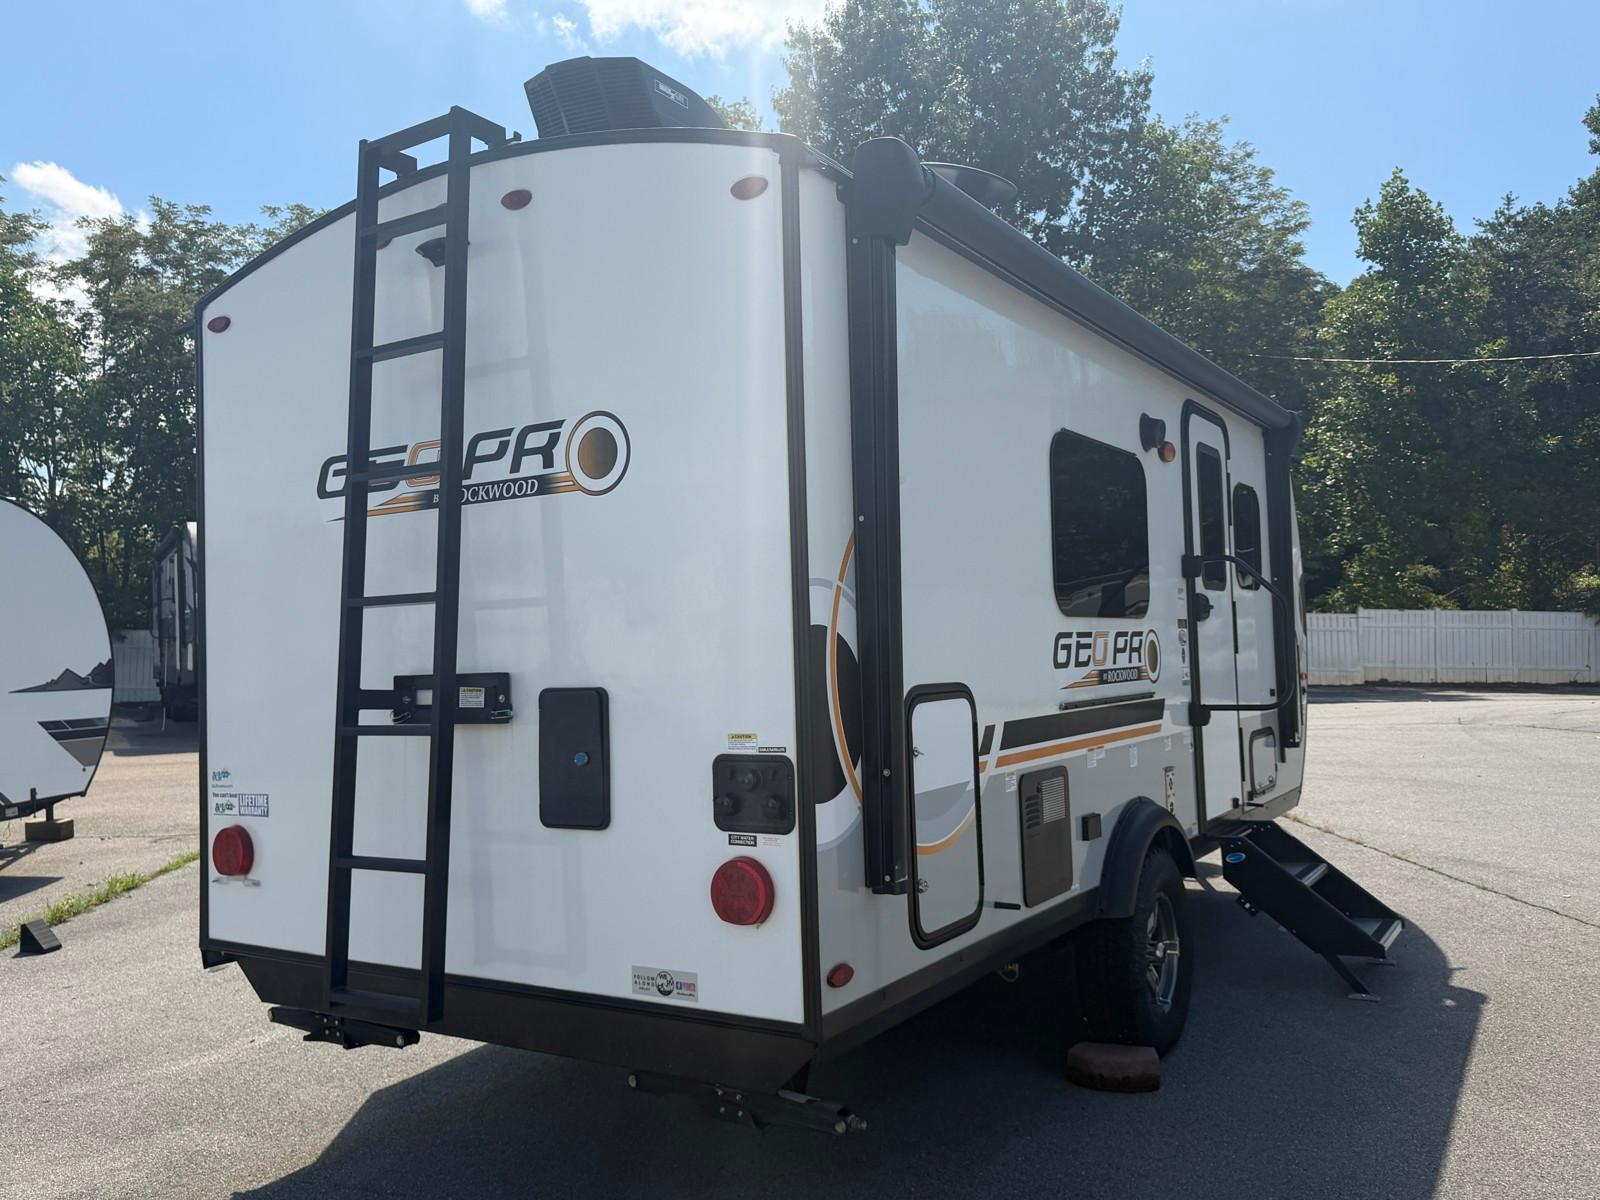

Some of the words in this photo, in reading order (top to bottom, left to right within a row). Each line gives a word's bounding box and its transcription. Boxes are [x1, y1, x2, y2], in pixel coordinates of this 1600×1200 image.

[462, 410, 631, 496] PRO
[1053, 631, 1109, 669] GEO
[1113, 629, 1161, 684] PRO
[1108, 669, 1138, 682] ROCKWOOD
[240, 794, 268, 806] LIFETIME
[240, 806, 268, 816] WARRANTY
